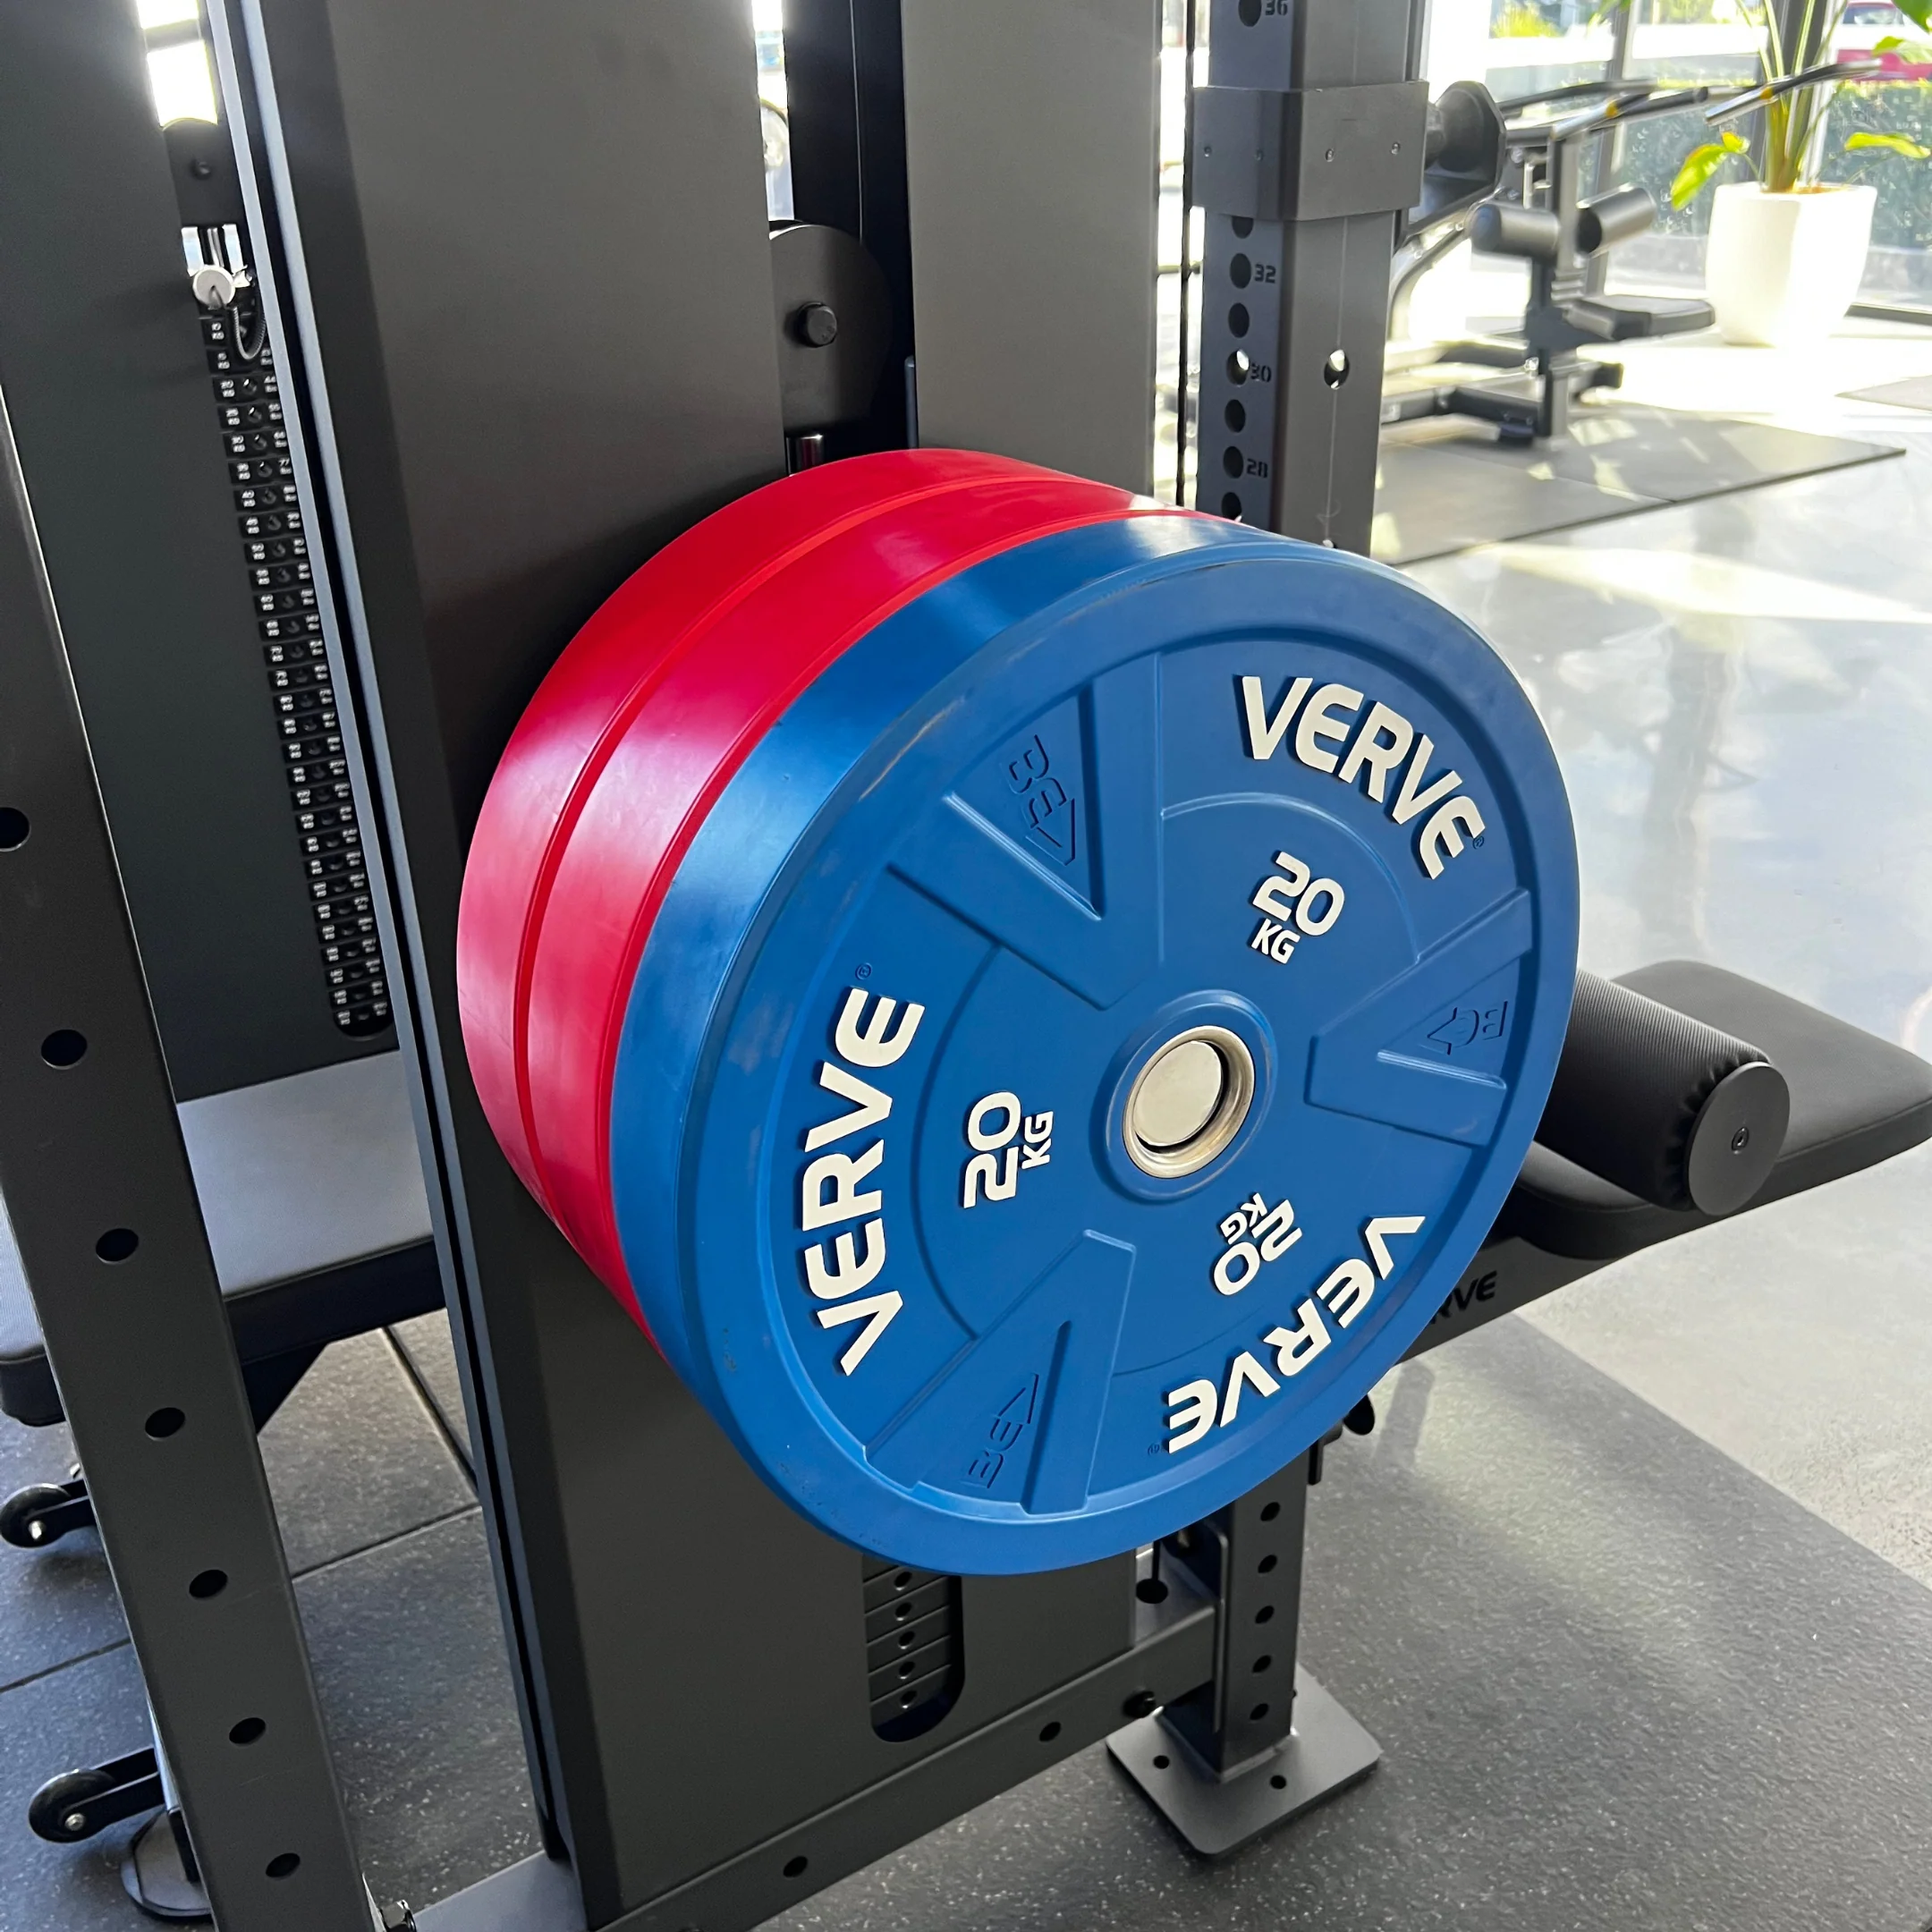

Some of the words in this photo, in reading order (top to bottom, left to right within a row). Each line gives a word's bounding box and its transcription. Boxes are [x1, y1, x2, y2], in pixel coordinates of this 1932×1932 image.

[1264, 0, 1288, 16] 36
[1254, 264, 1276, 284] 32
[1250, 363, 1272, 383] 30
[1246, 459, 1268, 479] 28
[1241, 675, 1486, 880] VERVE
[1252, 852, 1345, 936] 20
[1251, 918, 1301, 964] KG
[963, 1090, 1021, 1208] 20
[1021, 1110, 1054, 1170] KG
[802, 987, 926, 1377] VERVE
[1213, 1199, 1303, 1295] 20
[1220, 1192, 1267, 1245] KG
[1168, 1216, 1426, 1454] VERVE
